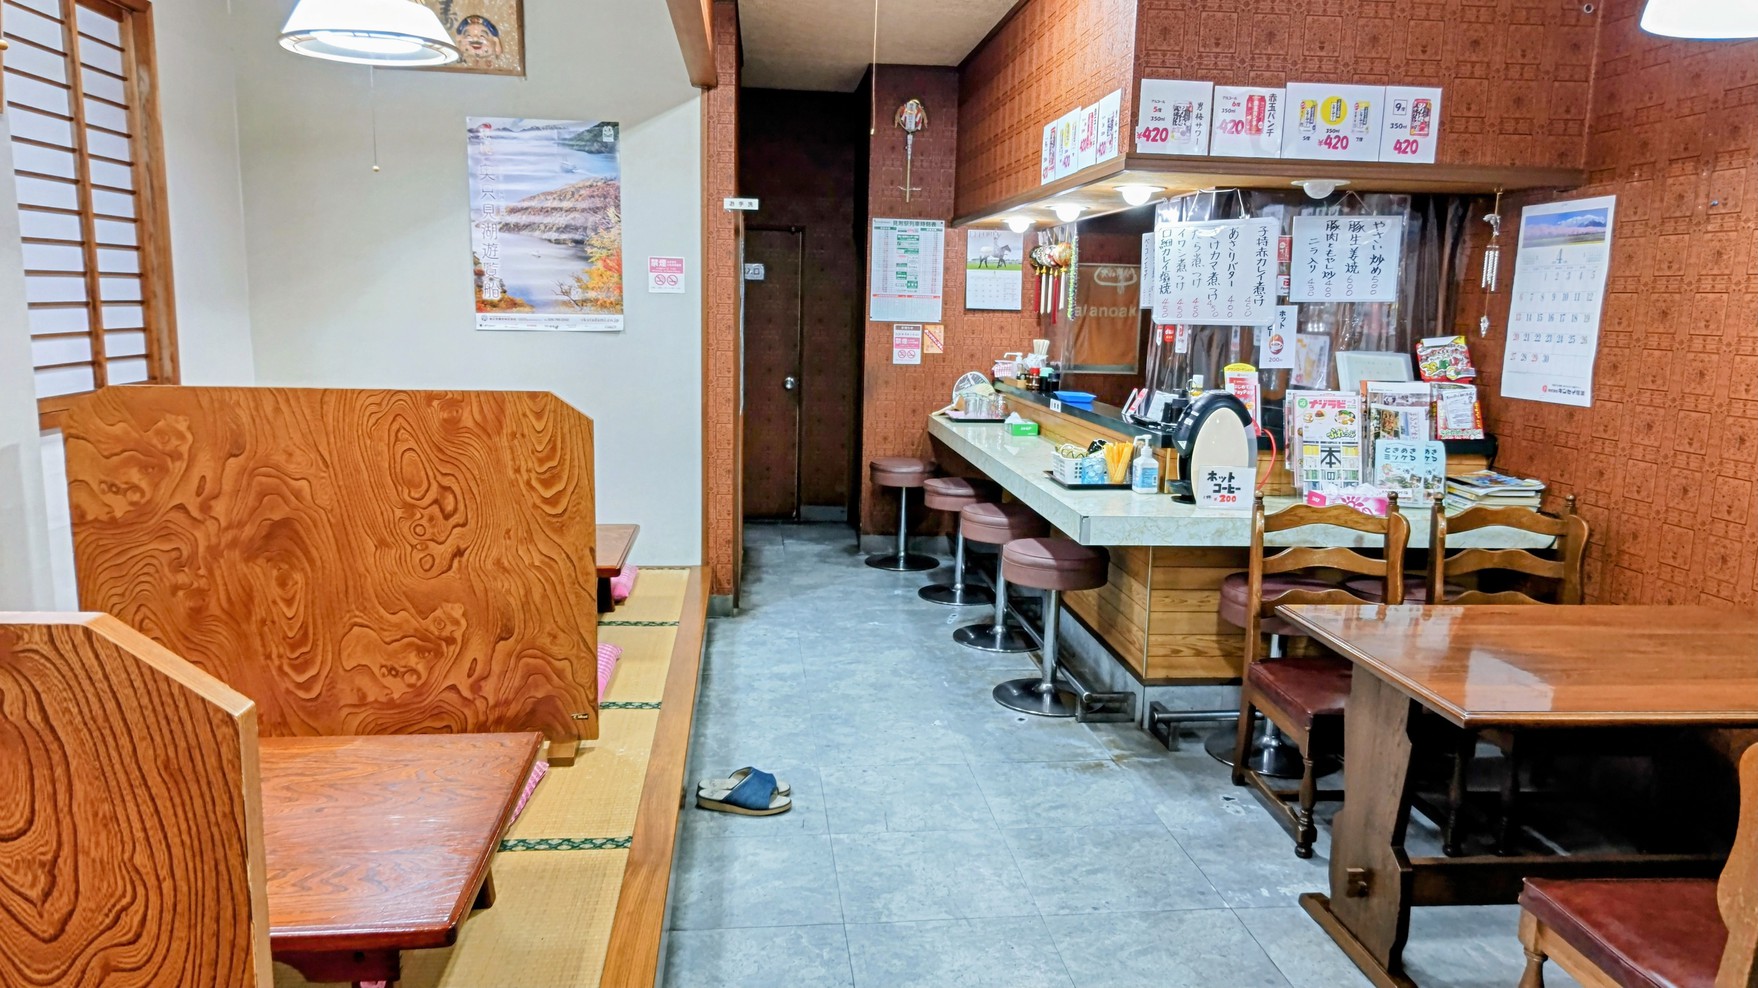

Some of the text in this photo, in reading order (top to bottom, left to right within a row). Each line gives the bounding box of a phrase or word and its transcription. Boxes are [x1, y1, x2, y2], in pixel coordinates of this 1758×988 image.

[1194, 102, 1205, 145] 男梅サワー
[1266, 93, 1278, 137] 赤玉パンチ
[1389, 122, 1408, 130] 350ml
[1136, 127, 1169, 143] ¥420
[1317, 134, 1349, 151] ¥420
[479, 164, 502, 300] 奥只見湖遊覧船
[1306, 237, 1320, 274] ニラ入り
[1322, 219, 1341, 299] 豚肉ともやし炒 400
[1345, 220, 1366, 297] 豚生姜焼 600
[1369, 221, 1386, 297] やさい炒め 500
[1556, 248, 1563, 264] 4
[1207, 233, 1221, 301] けカマ煮つけ
[1226, 227, 1240, 319] あさりバター 400
[1555, 272, 1559, 281] 2
[1566, 272, 1571, 280] 3
[1551, 293, 1556, 301] 9
[1562, 293, 1569, 301] 10
[1573, 293, 1581, 301] 11
[1586, 293, 1594, 301] 12
[1245, 296, 1254, 318] 450
[1279, 310, 1287, 330] ホット
[1526, 313, 1532, 322] 14
[1536, 313, 1544, 322] 15
[1547, 313, 1555, 322] 16
[1559, 314, 1566, 323] 17
[1571, 314, 1578, 323] 18
[1583, 314, 1590, 323] 19
[1523, 333, 1530, 342] 21
[1534, 333, 1541, 342] 22
[1545, 334, 1553, 343] 23
[1556, 335, 1563, 344] 24
[1567, 335, 1575, 344] 25
[1520, 353, 1527, 362] 28
[1542, 354, 1549, 363] 30
[1384, 447, 1417, 455] ときめき
[1207, 470, 1236, 483] ホット
[1213, 483, 1241, 494] コーヒー
